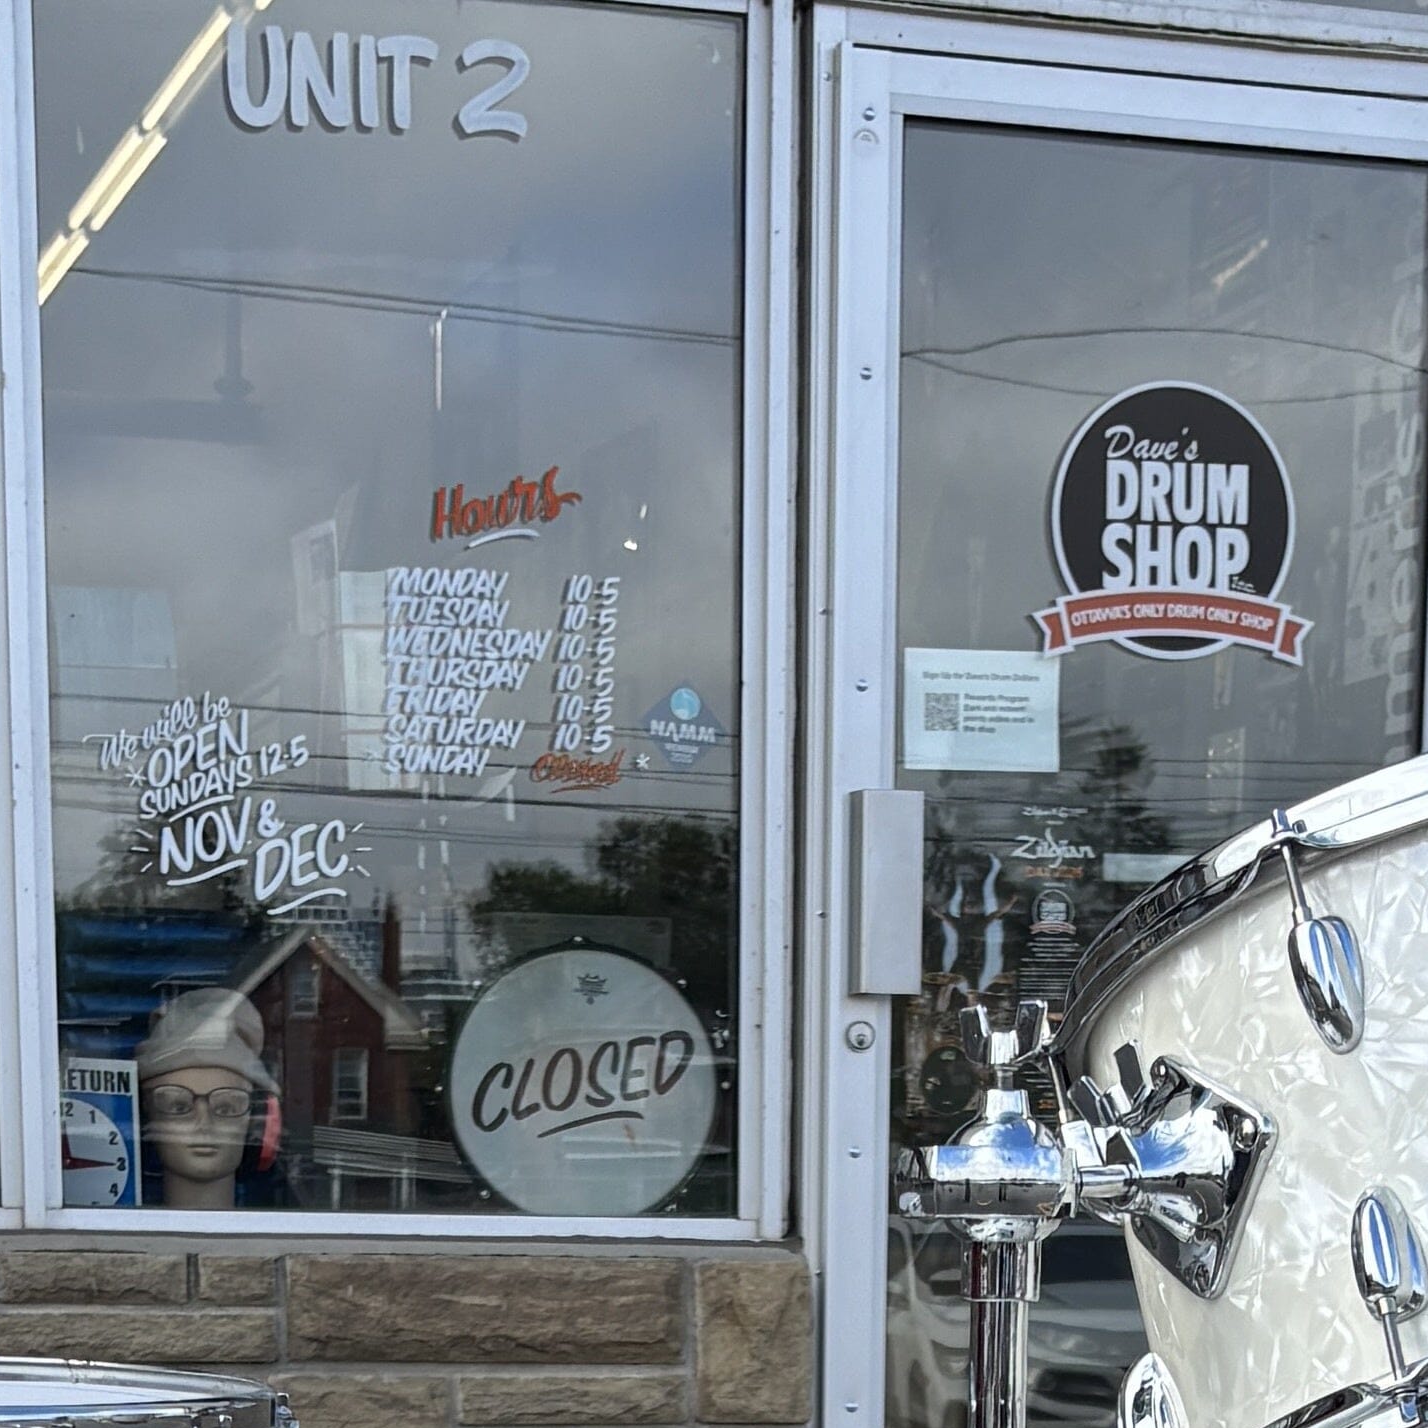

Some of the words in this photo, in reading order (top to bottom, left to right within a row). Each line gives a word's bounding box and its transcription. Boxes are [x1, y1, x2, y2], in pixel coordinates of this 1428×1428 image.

[227, 20, 439, 130] UNIT
[458, 38, 531, 138] 2
[1104, 425, 1200, 461] Dave's
[431, 466, 583, 541] Hours
[1105, 459, 1250, 525] DRUM
[1101, 522, 1251, 592] SHOP
[390, 566, 509, 600] MONDAY
[567, 574, 621, 606] 10-5
[389, 594, 510, 627] TUESDAY
[564, 604, 618, 635] 10-5
[1071, 603, 1133, 627] OTTAWA'S
[1133, 602, 1166, 619] ONLY
[1167, 602, 1205, 620] DRUM
[1207, 606, 1239, 624] ONLY
[1240, 611, 1275, 632] SHOP
[386, 625, 554, 662] WEDNESDAY
[560, 633, 616, 666] 10-5
[388, 653, 531, 691] THURSDAY
[557, 663, 615, 697] 10-5
[385, 686, 489, 717] FRIDAY
[556, 693, 614, 724] 10-5
[98, 729, 138, 771] We
[141, 696, 198, 750] will
[202, 690, 232, 724] be
[147, 708, 249, 788] OPEN
[384, 713, 526, 749] SATURDAY
[554, 723, 615, 754] 10-5
[139, 754, 253, 820] SUNDAYS
[258, 735, 310, 777] 12-5
[384, 743, 490, 777] SUNDAY
[257, 799, 285, 838] &
[1010, 827, 1098, 869] Zildjian
[471, 1029, 696, 1133] CLOSED
[88, 1109, 96, 1125] 1
[108, 1131, 119, 1146] 2
[116, 1156, 127, 1172] 3
[108, 1183, 120, 1198] 4
